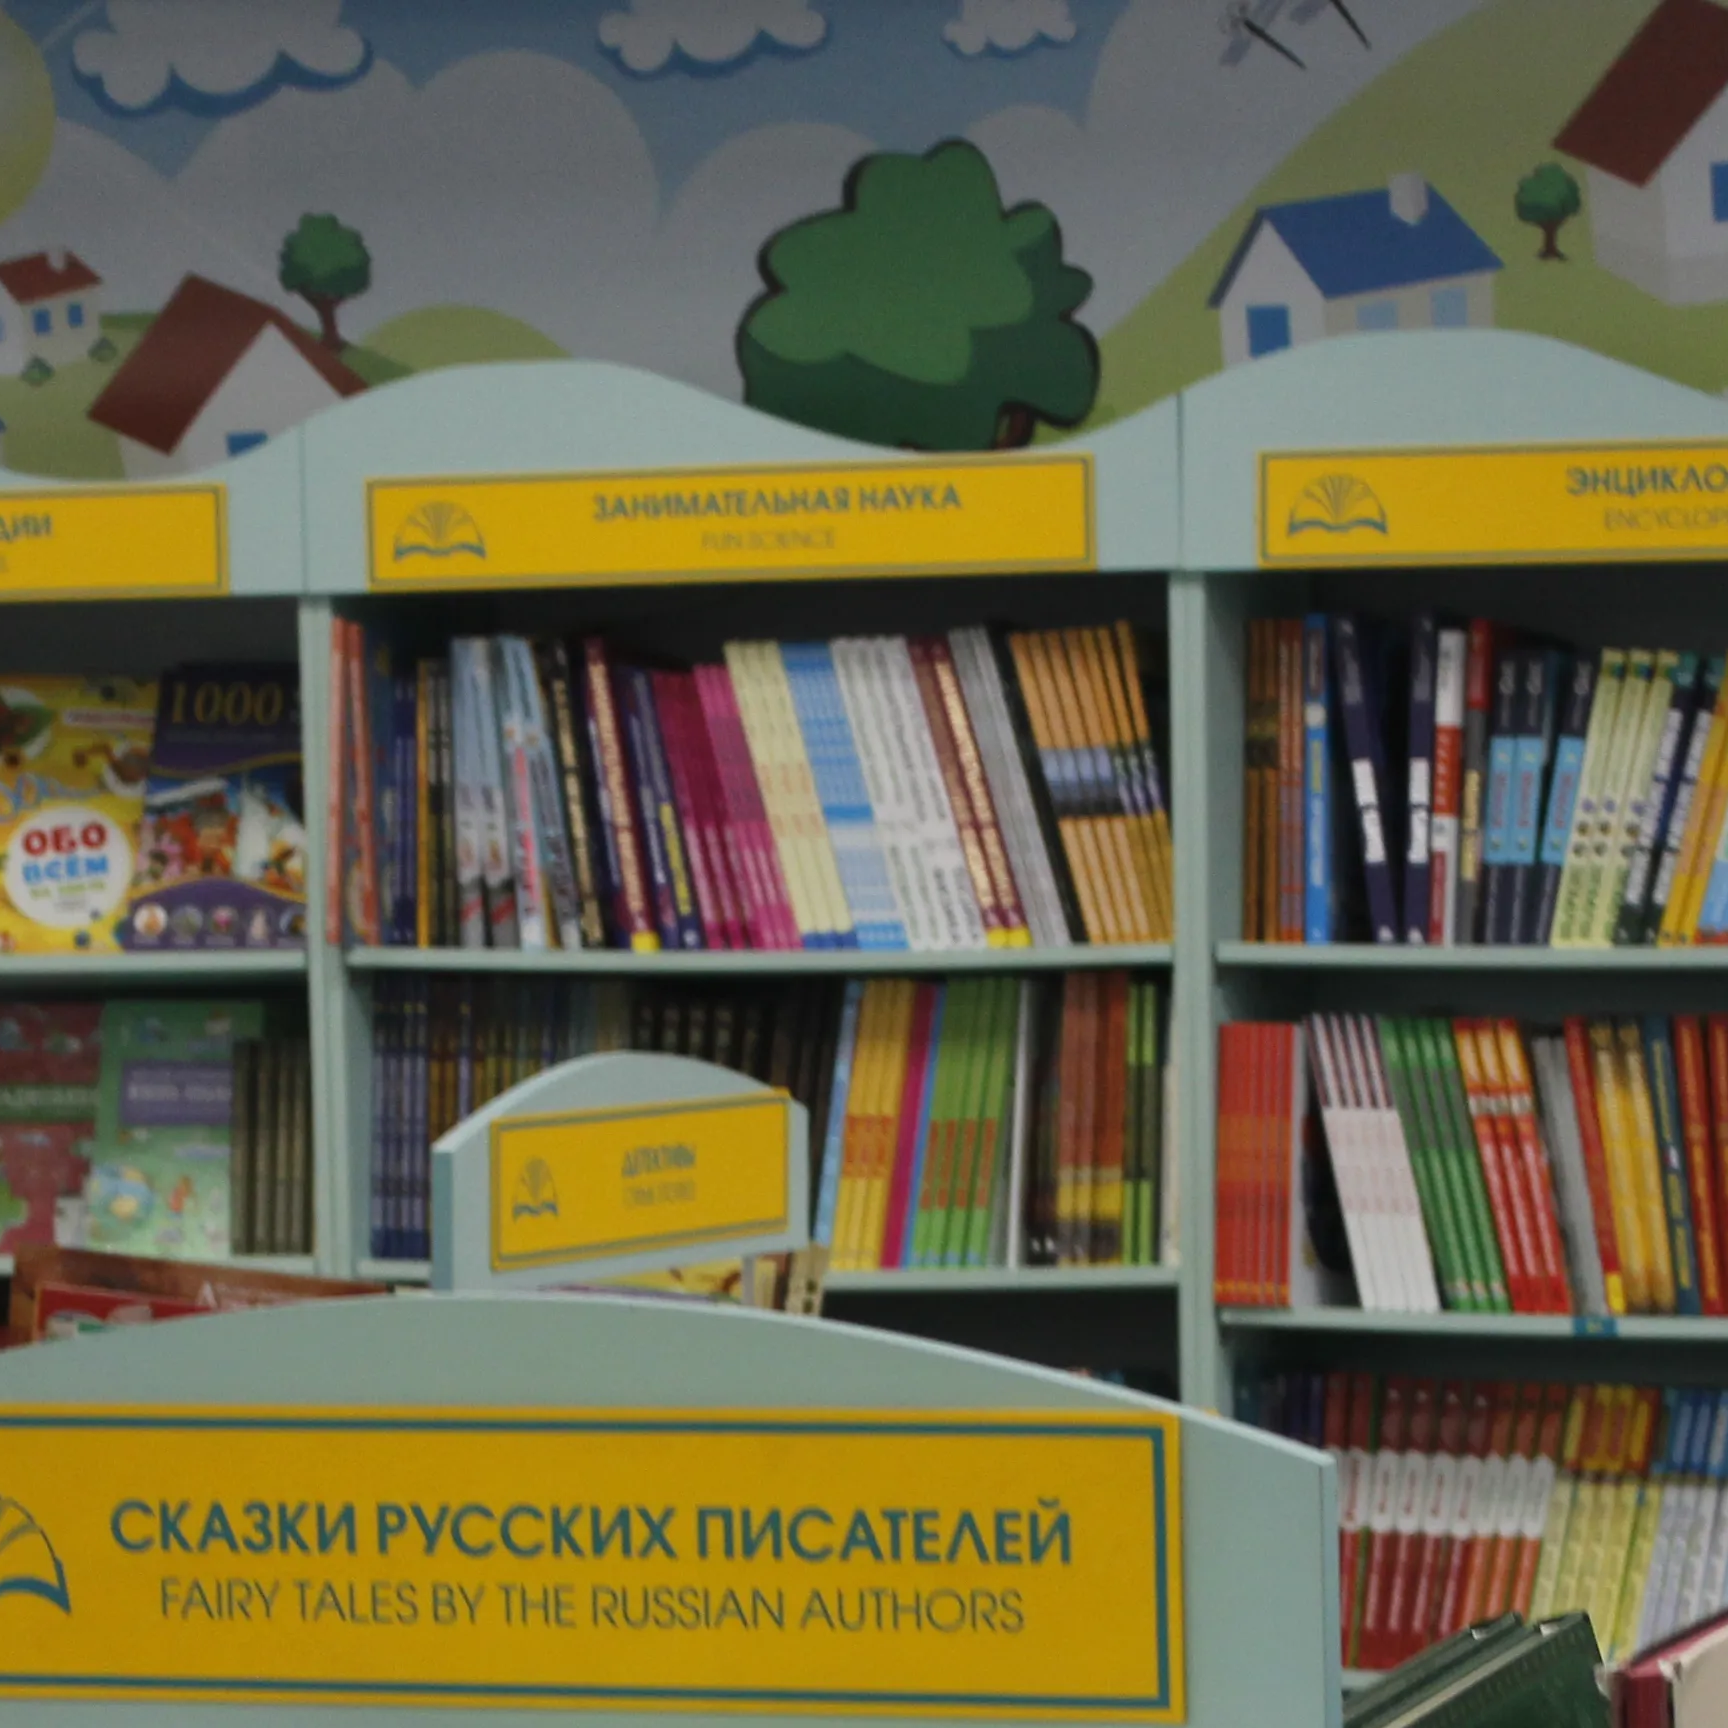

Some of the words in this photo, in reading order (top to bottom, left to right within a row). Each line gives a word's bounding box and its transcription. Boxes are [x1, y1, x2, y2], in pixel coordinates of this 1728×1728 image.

[592, 486, 851, 524] ЗАНИМАТЕЛЬНАЯ
[860, 483, 961, 513] НАУКА
[109, 1497, 357, 1557] СКАЗКИ
[377, 1501, 676, 1563] РУССКИХ
[695, 1494, 1075, 1568] ПИСАТЕЛЕЙ
[160, 1577, 285, 1624] FAIRY
[290, 1578, 420, 1626] TALES
[431, 1580, 487, 1627] BY
[493, 1581, 576, 1628] THE
[589, 1582, 784, 1631] RUSSIAN
[798, 1583, 1026, 1635] AUTHORS
